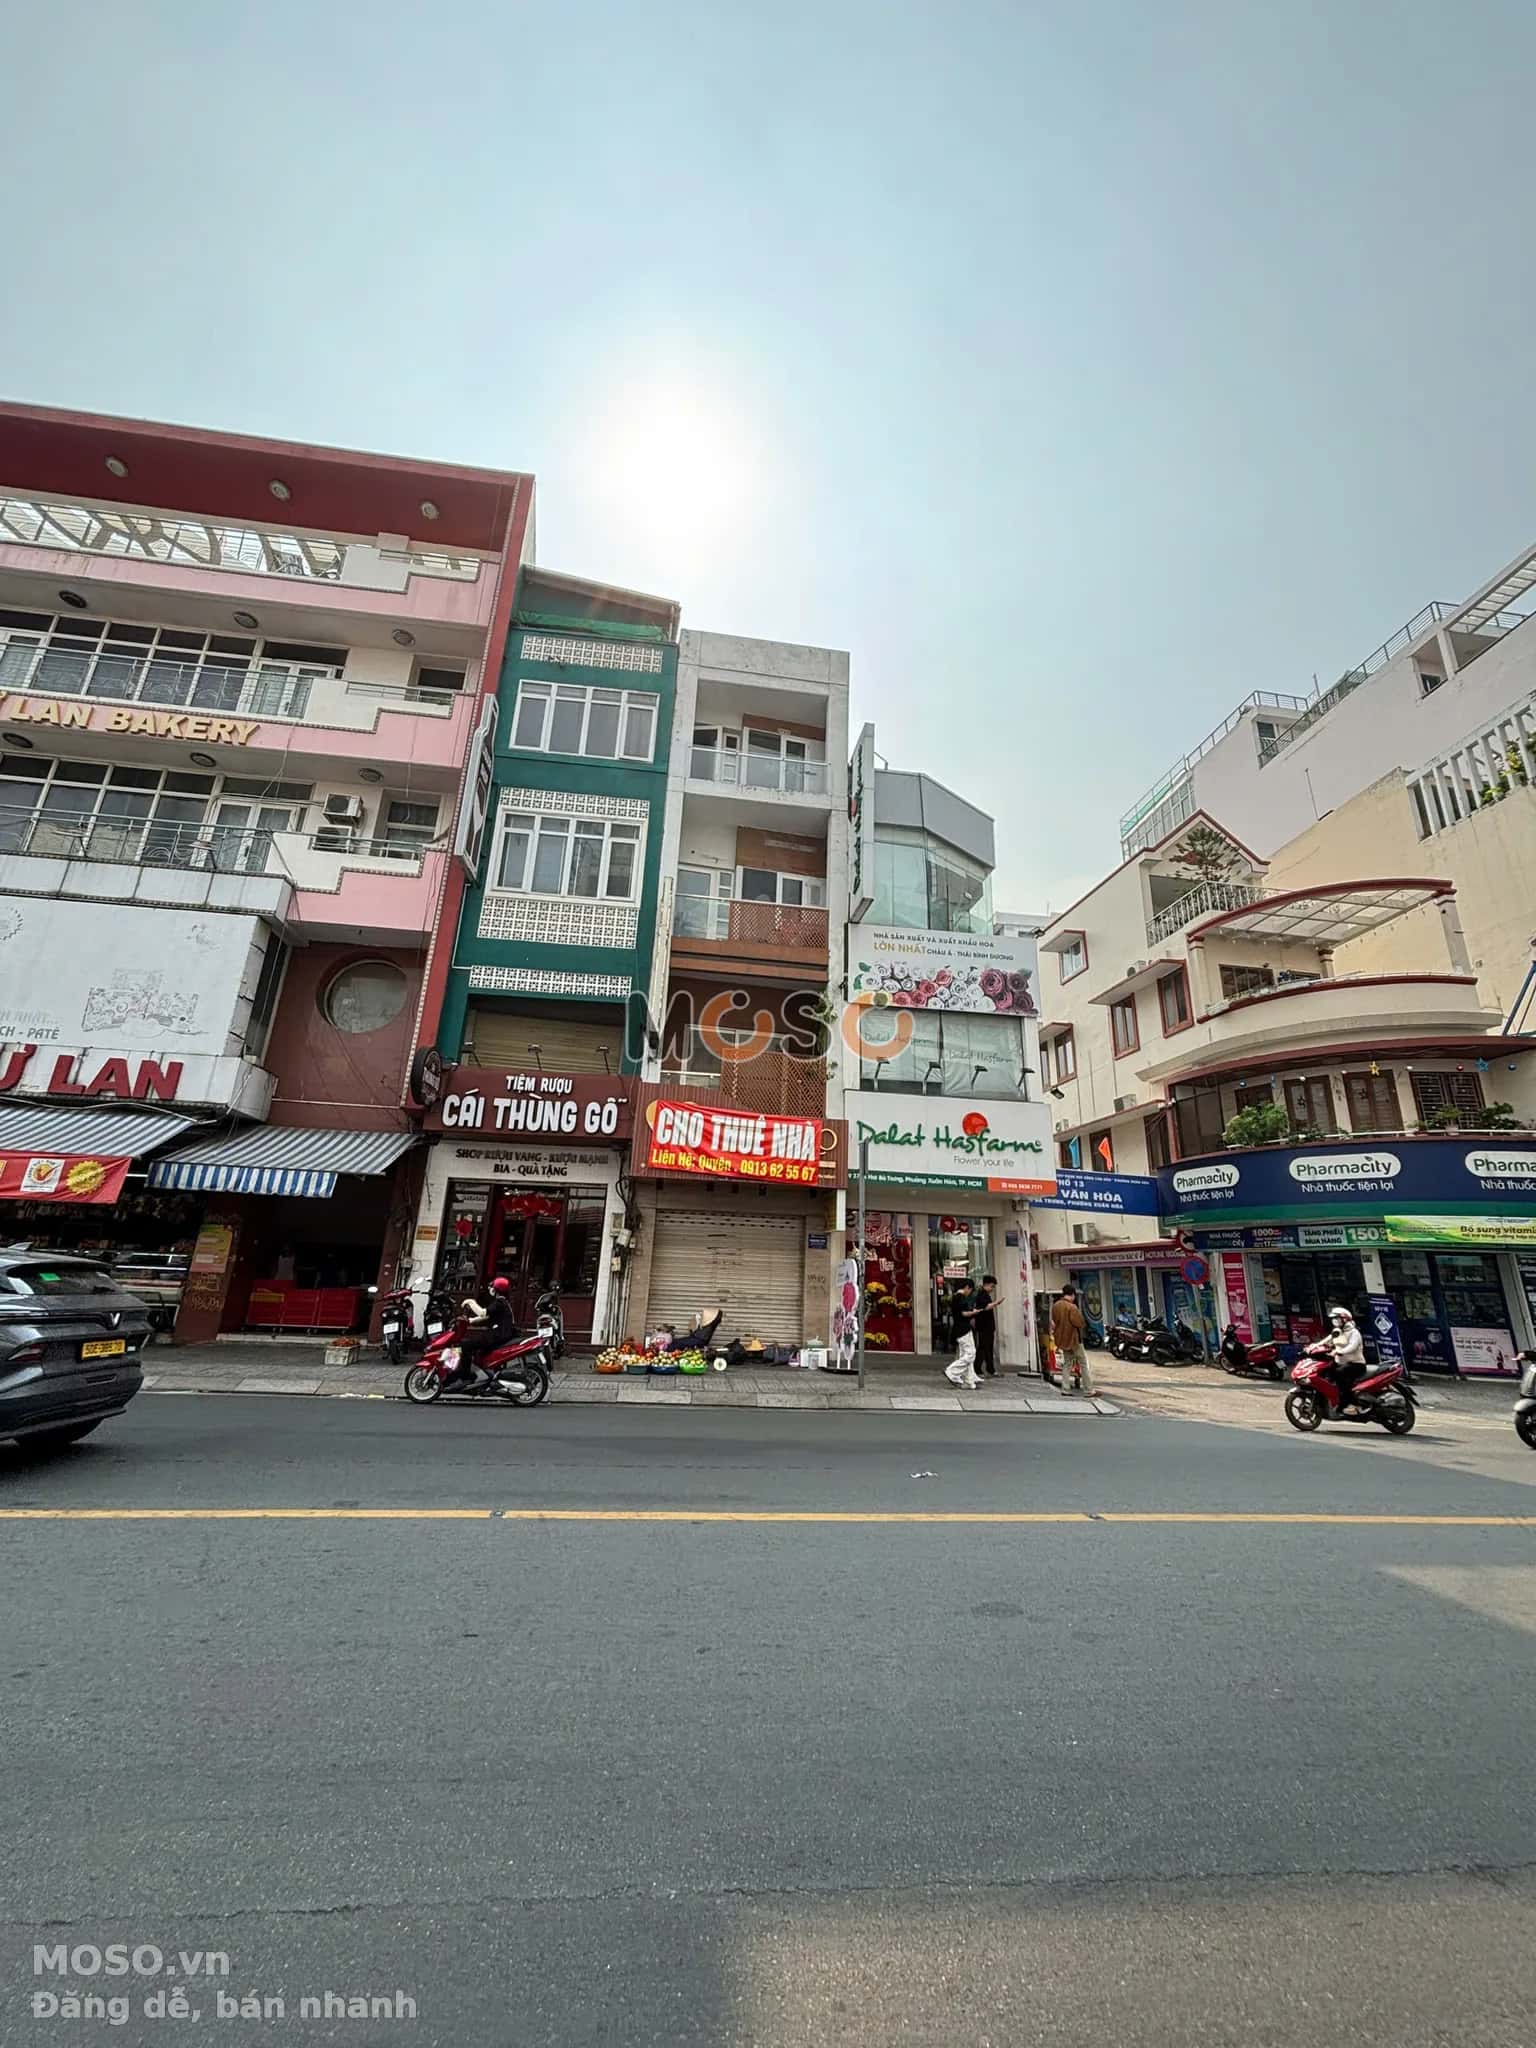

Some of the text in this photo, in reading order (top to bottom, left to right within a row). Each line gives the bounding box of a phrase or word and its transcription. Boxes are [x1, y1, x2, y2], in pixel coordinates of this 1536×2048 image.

[10, 699, 261, 745] LAN BAKERY
[48, 1054, 184, 1100] LAN
[506, 1073, 573, 1096] TIỆM RƯỢU
[442, 1088, 628, 1134] CÁI THÙNG GỖ
[655, 1107, 816, 1161] CHO THUÊ NHÀ
[856, 1120, 1043, 1156] Dalat Hasfarm
[456, 1148, 484, 1160] SHOP
[514, 1150, 542, 1163] VANG
[954, 1155, 981, 1166] Flower
[982, 1157, 1001, 1168] your
[493, 1164, 511, 1174] BIA
[518, 1164, 540, 1176] QUÀ
[652, 1148, 676, 1165] Liên
[740, 1159, 768, 1177] 0913
[769, 1161, 783, 1178] 62
[785, 1164, 800, 1180] 55
[801, 1166, 816, 1182] 67
[1296, 1156, 1392, 1177] Pharmacity
[1074, 1180, 1085, 1188] 13
[1176, 1168, 1234, 1189] Pharmacity
[1301, 1179, 1394, 1193] Nhà thuốc tiện lợi
[1480, 1179, 1505, 1190] Nhà
[1060, 1188, 1123, 1203] VĂN HÓA
[1253, 1228, 1274, 1237] 1000
[1477, 1226, 1501, 1235] sung
